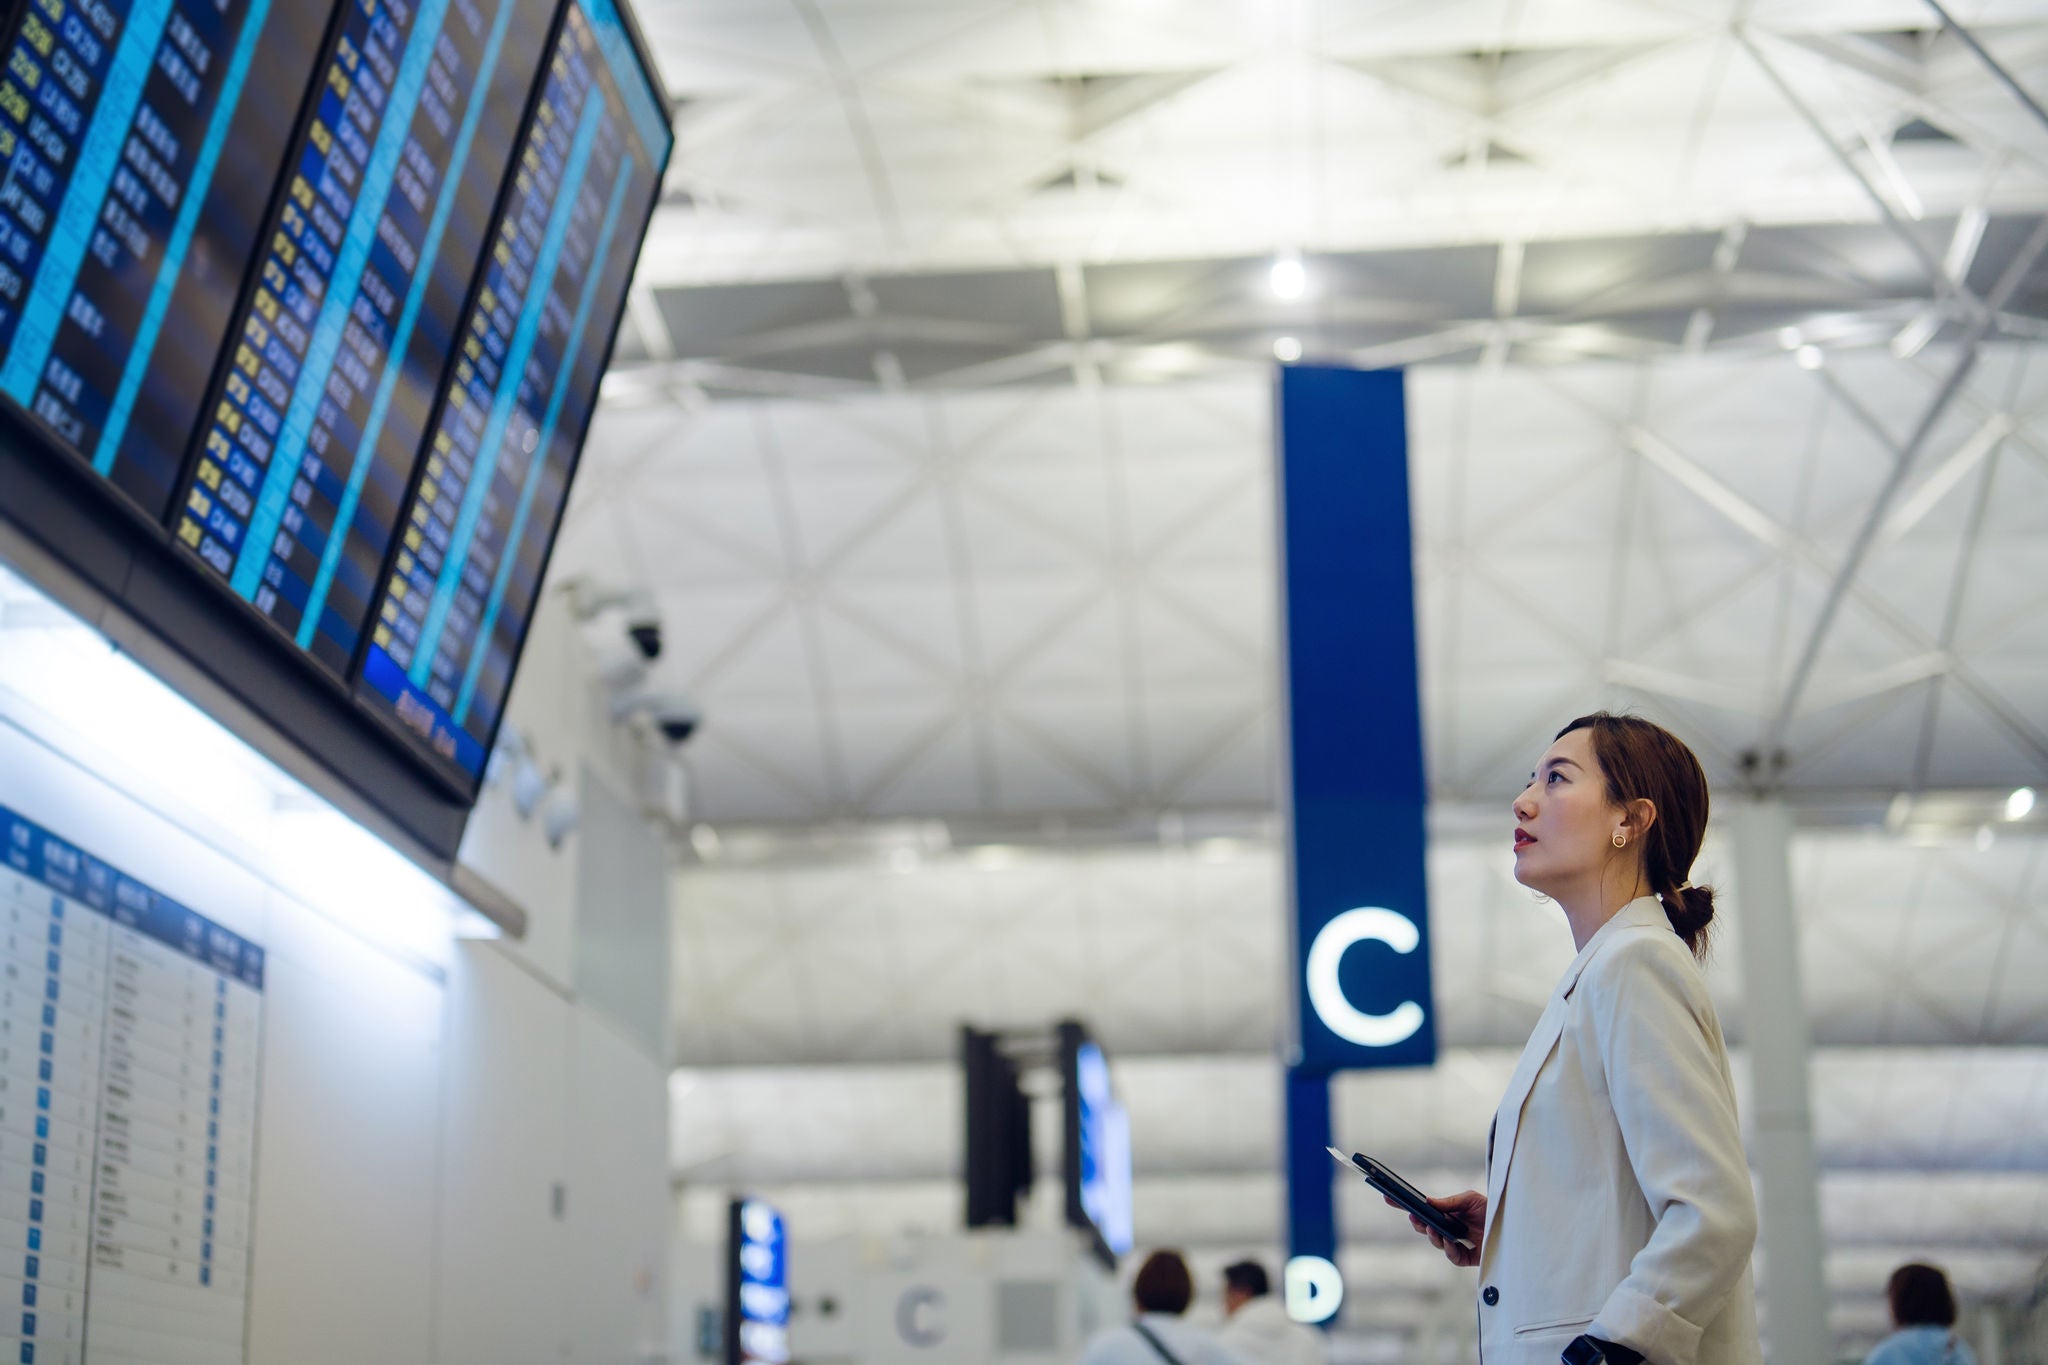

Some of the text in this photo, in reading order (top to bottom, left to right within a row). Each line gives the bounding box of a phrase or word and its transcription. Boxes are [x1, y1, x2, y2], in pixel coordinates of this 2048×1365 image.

[1307, 907, 1425, 1047] C
[895, 1285, 947, 1348] C
[1285, 1256, 1344, 1323] D
